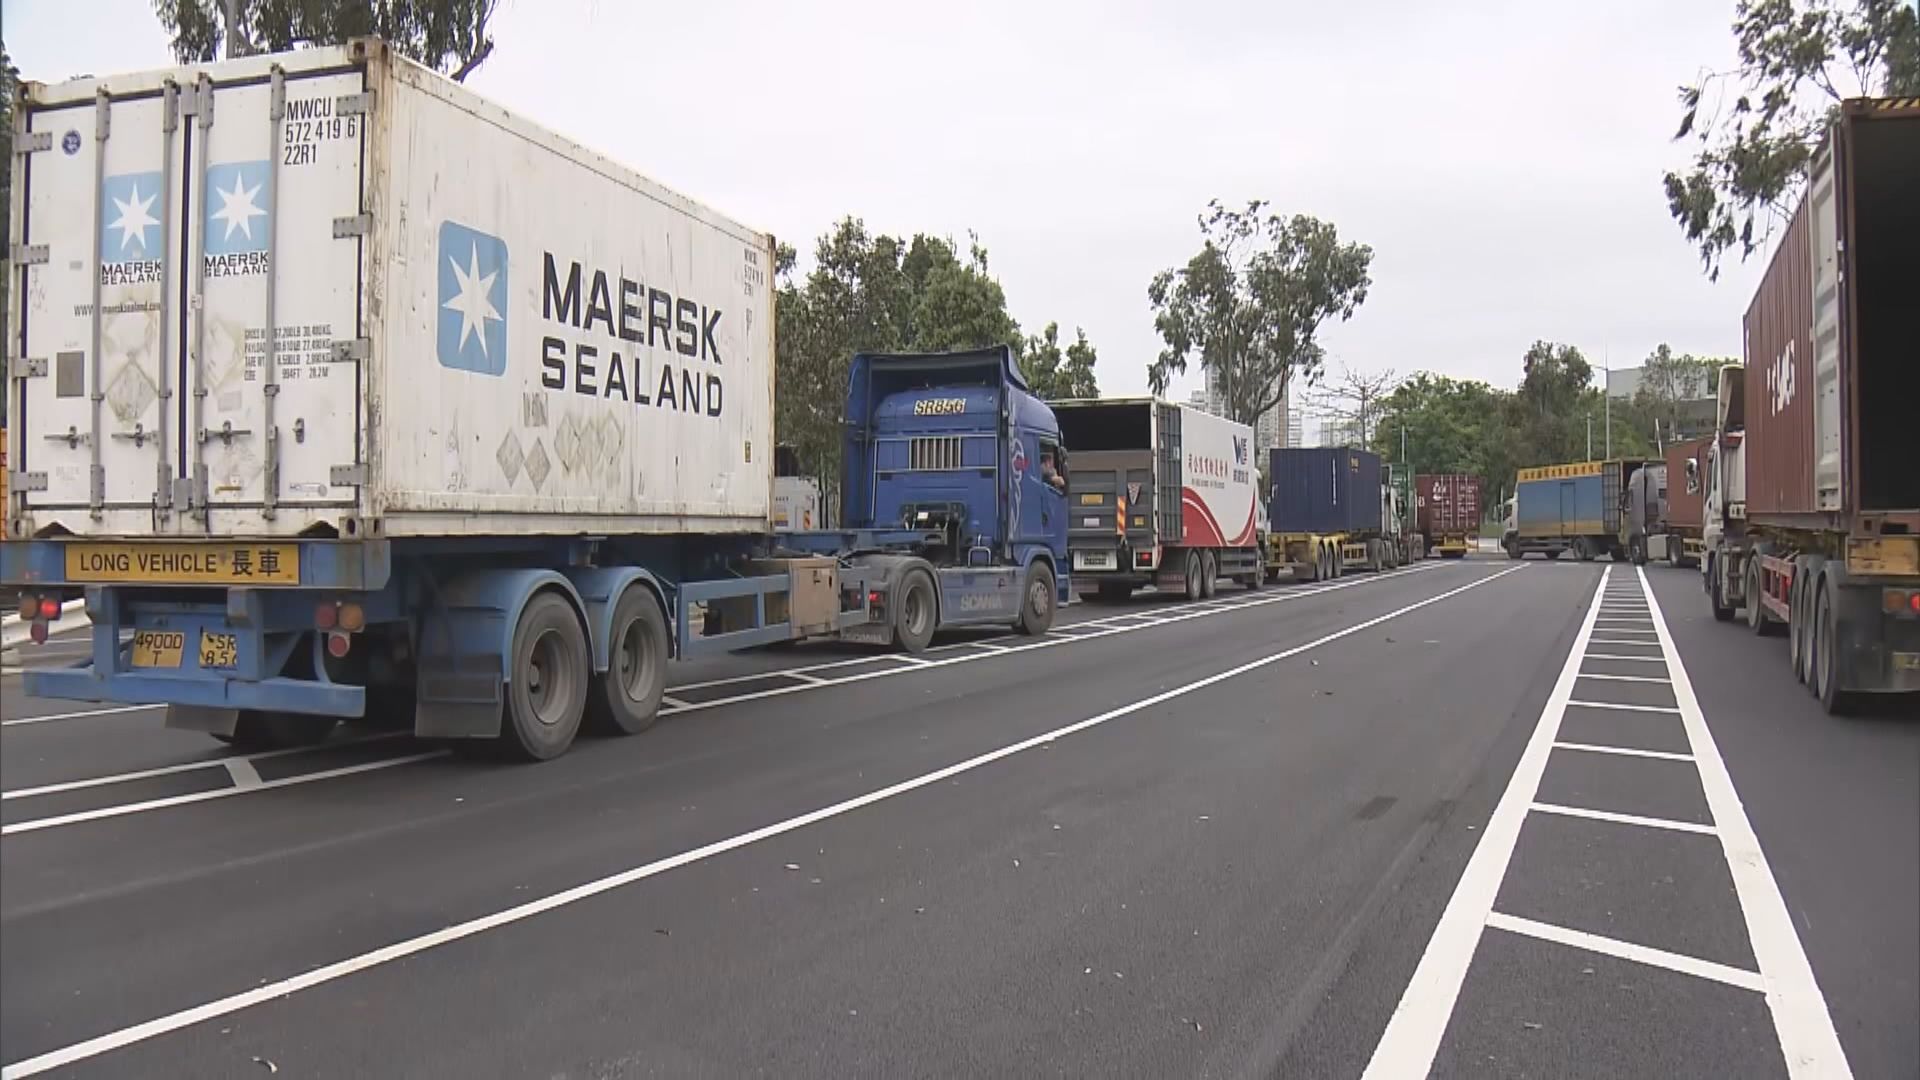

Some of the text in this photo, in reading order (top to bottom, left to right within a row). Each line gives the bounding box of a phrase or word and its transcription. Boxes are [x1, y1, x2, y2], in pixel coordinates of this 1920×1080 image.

[287, 97, 331, 121] MWCU
[285, 117, 356, 143] 572 419 6
[284, 144, 317, 165] 22R1
[101, 260, 162, 276] MAERSK
[204, 252, 269, 268] MAERSK
[543, 250, 722, 365] MAERSK
[541, 335, 723, 418] SEALAND
[80, 553, 217, 573] LONG VEHICLE
[232, 548, 281, 577] 長車
[135, 633, 183, 651] 49000
[152, 651, 162, 666] T
